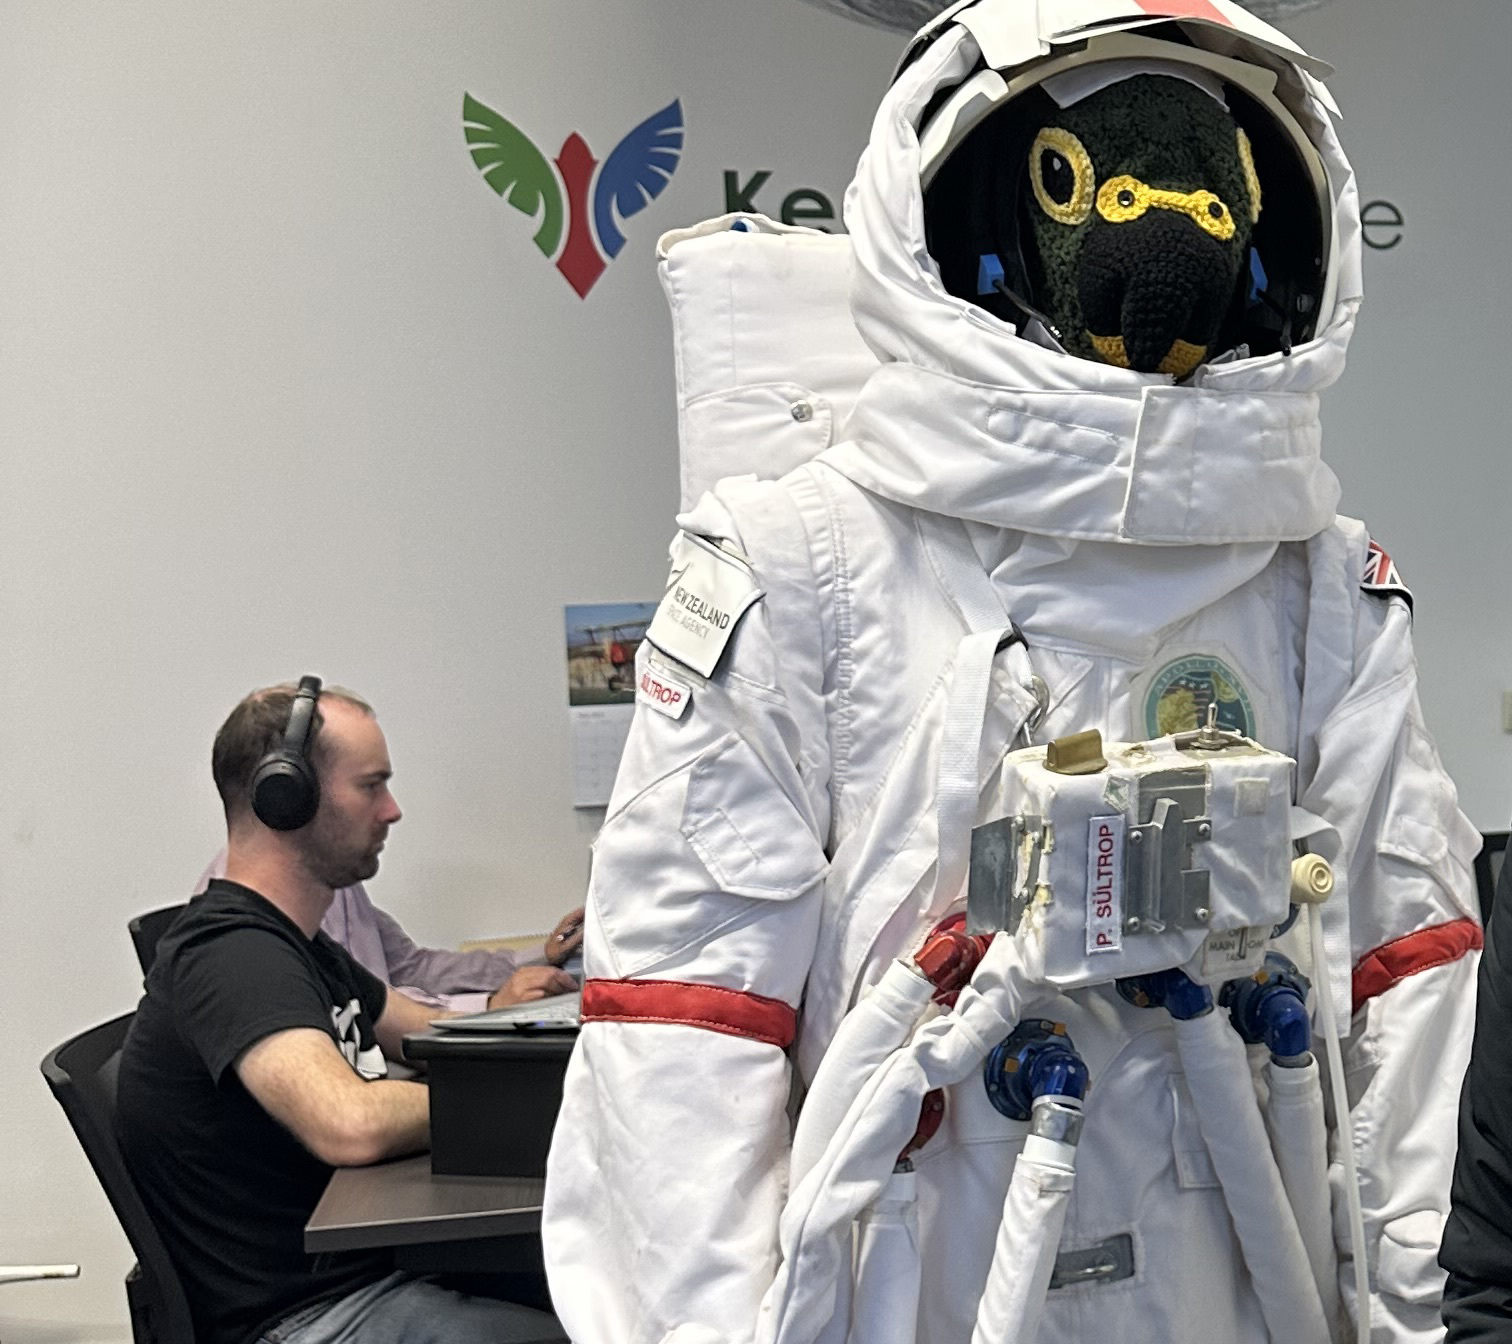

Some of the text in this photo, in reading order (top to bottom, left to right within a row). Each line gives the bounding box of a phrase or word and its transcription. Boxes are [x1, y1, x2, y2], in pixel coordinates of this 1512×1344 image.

[723, 170, 835, 233] Ke
[685, 594, 731, 630] ZEALAND
[1092, 824, 1115, 946] P. SÜLTROP
